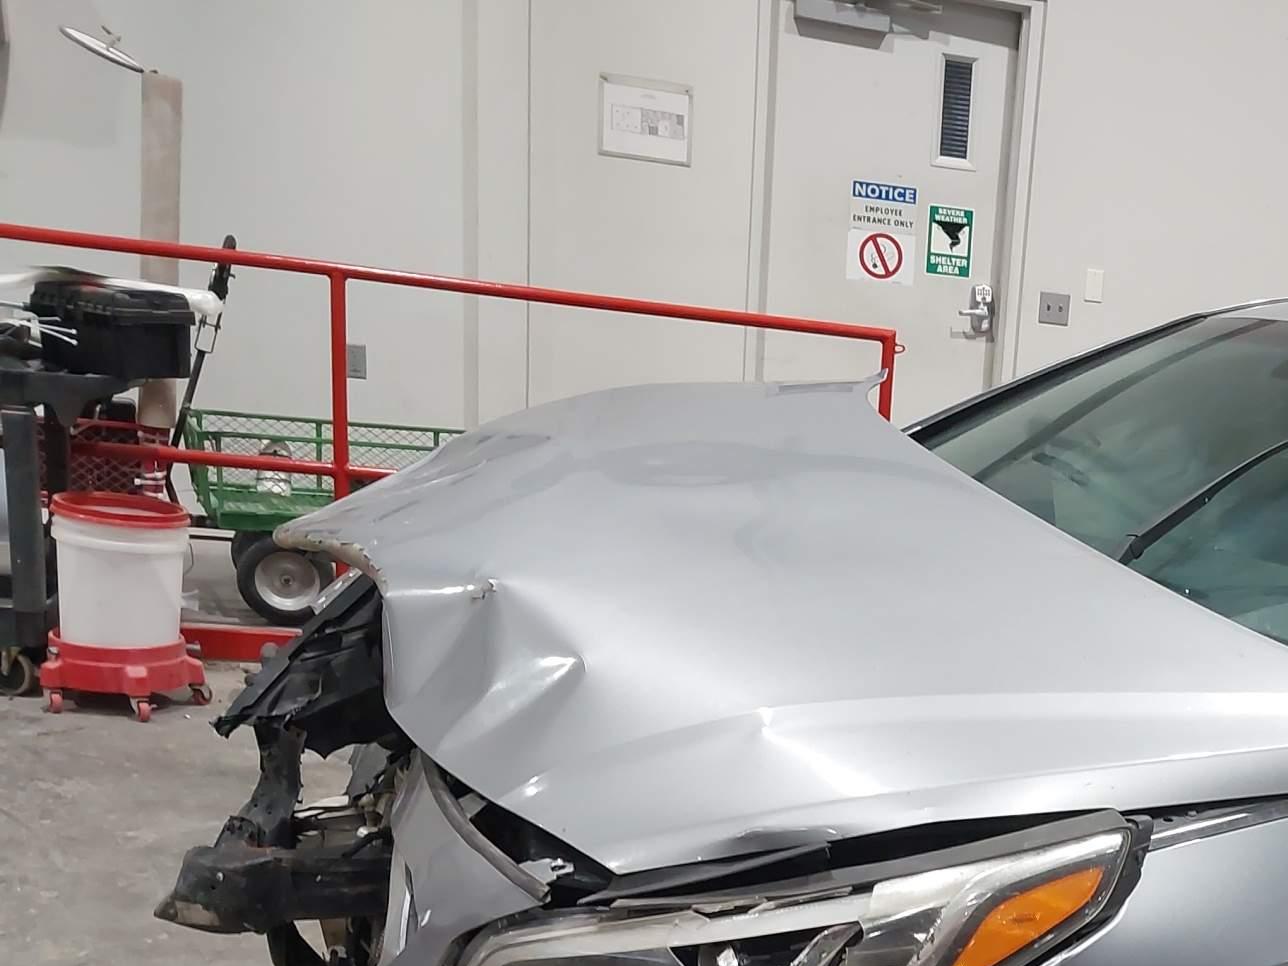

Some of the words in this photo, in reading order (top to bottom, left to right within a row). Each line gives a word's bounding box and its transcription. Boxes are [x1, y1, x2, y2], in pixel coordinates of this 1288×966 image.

[854, 182, 915, 203] NOTICE
[865, 205, 903, 217] EMPLOYEE
[938, 207, 965, 218] SEVERE
[852, 214, 892, 226] ENTRANCE
[894, 219, 914, 229] ONLY
[934, 213, 968, 224] WEATHER
[929, 255, 968, 268] SHELTER
[936, 265, 960, 275] AREA
